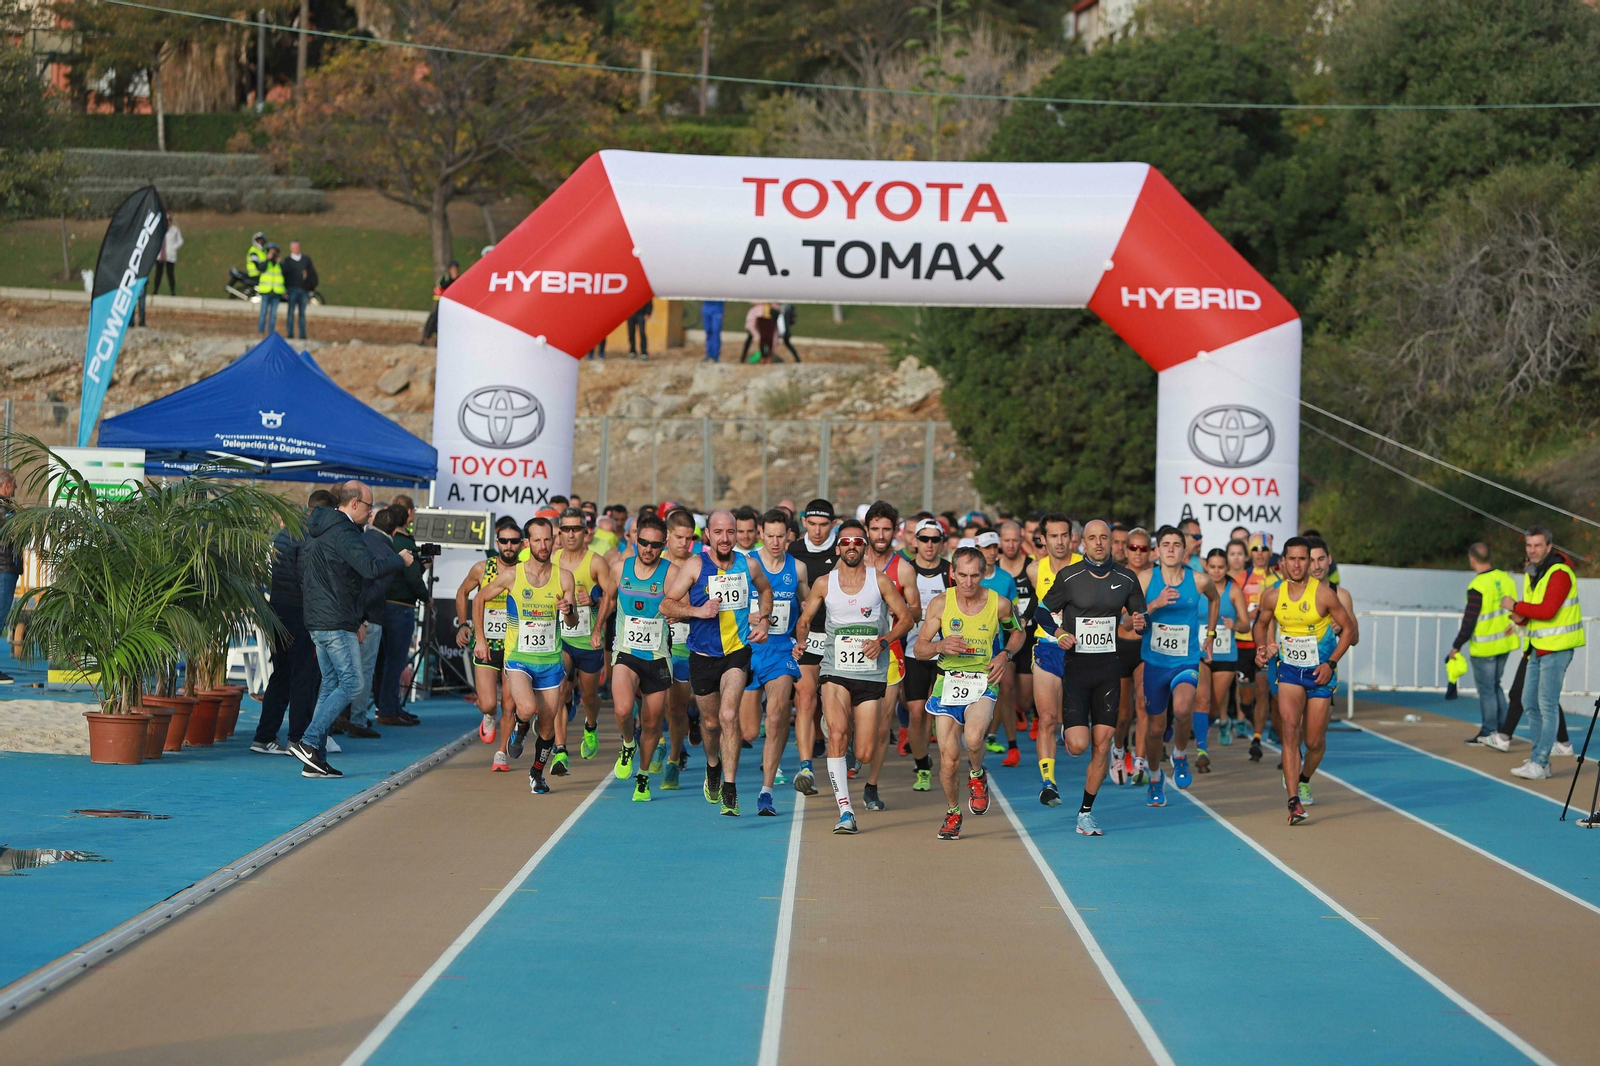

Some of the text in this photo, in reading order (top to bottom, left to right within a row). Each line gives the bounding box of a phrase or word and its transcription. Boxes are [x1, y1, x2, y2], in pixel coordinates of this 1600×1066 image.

[742, 177, 1008, 223] TOYOTA
[738, 236, 1005, 281] A. TOMAX
[488, 270, 628, 295] HYBRID
[87, 209, 163, 385] POWERADE
[1120, 286, 1262, 311] HYBRID
[222, 439, 316, 456] Delegación de Deportes
[450, 456, 548, 479] TOYOTA
[447, 483, 550, 506] A. TOMAX
[1180, 476, 1280, 497] TOYOTA
[1203, 503, 1282, 523] TOMAX
[715, 589, 740, 604] 319
[487, 621, 508, 633] 259
[524, 634, 546, 646] 133
[628, 630, 651, 644] 324
[1079, 632, 1113, 646] 1005A
[1156, 636, 1178, 650] 148
[840, 651, 865, 664] 312
[1286, 648, 1307, 661] 299
[952, 686, 969, 699] 39
